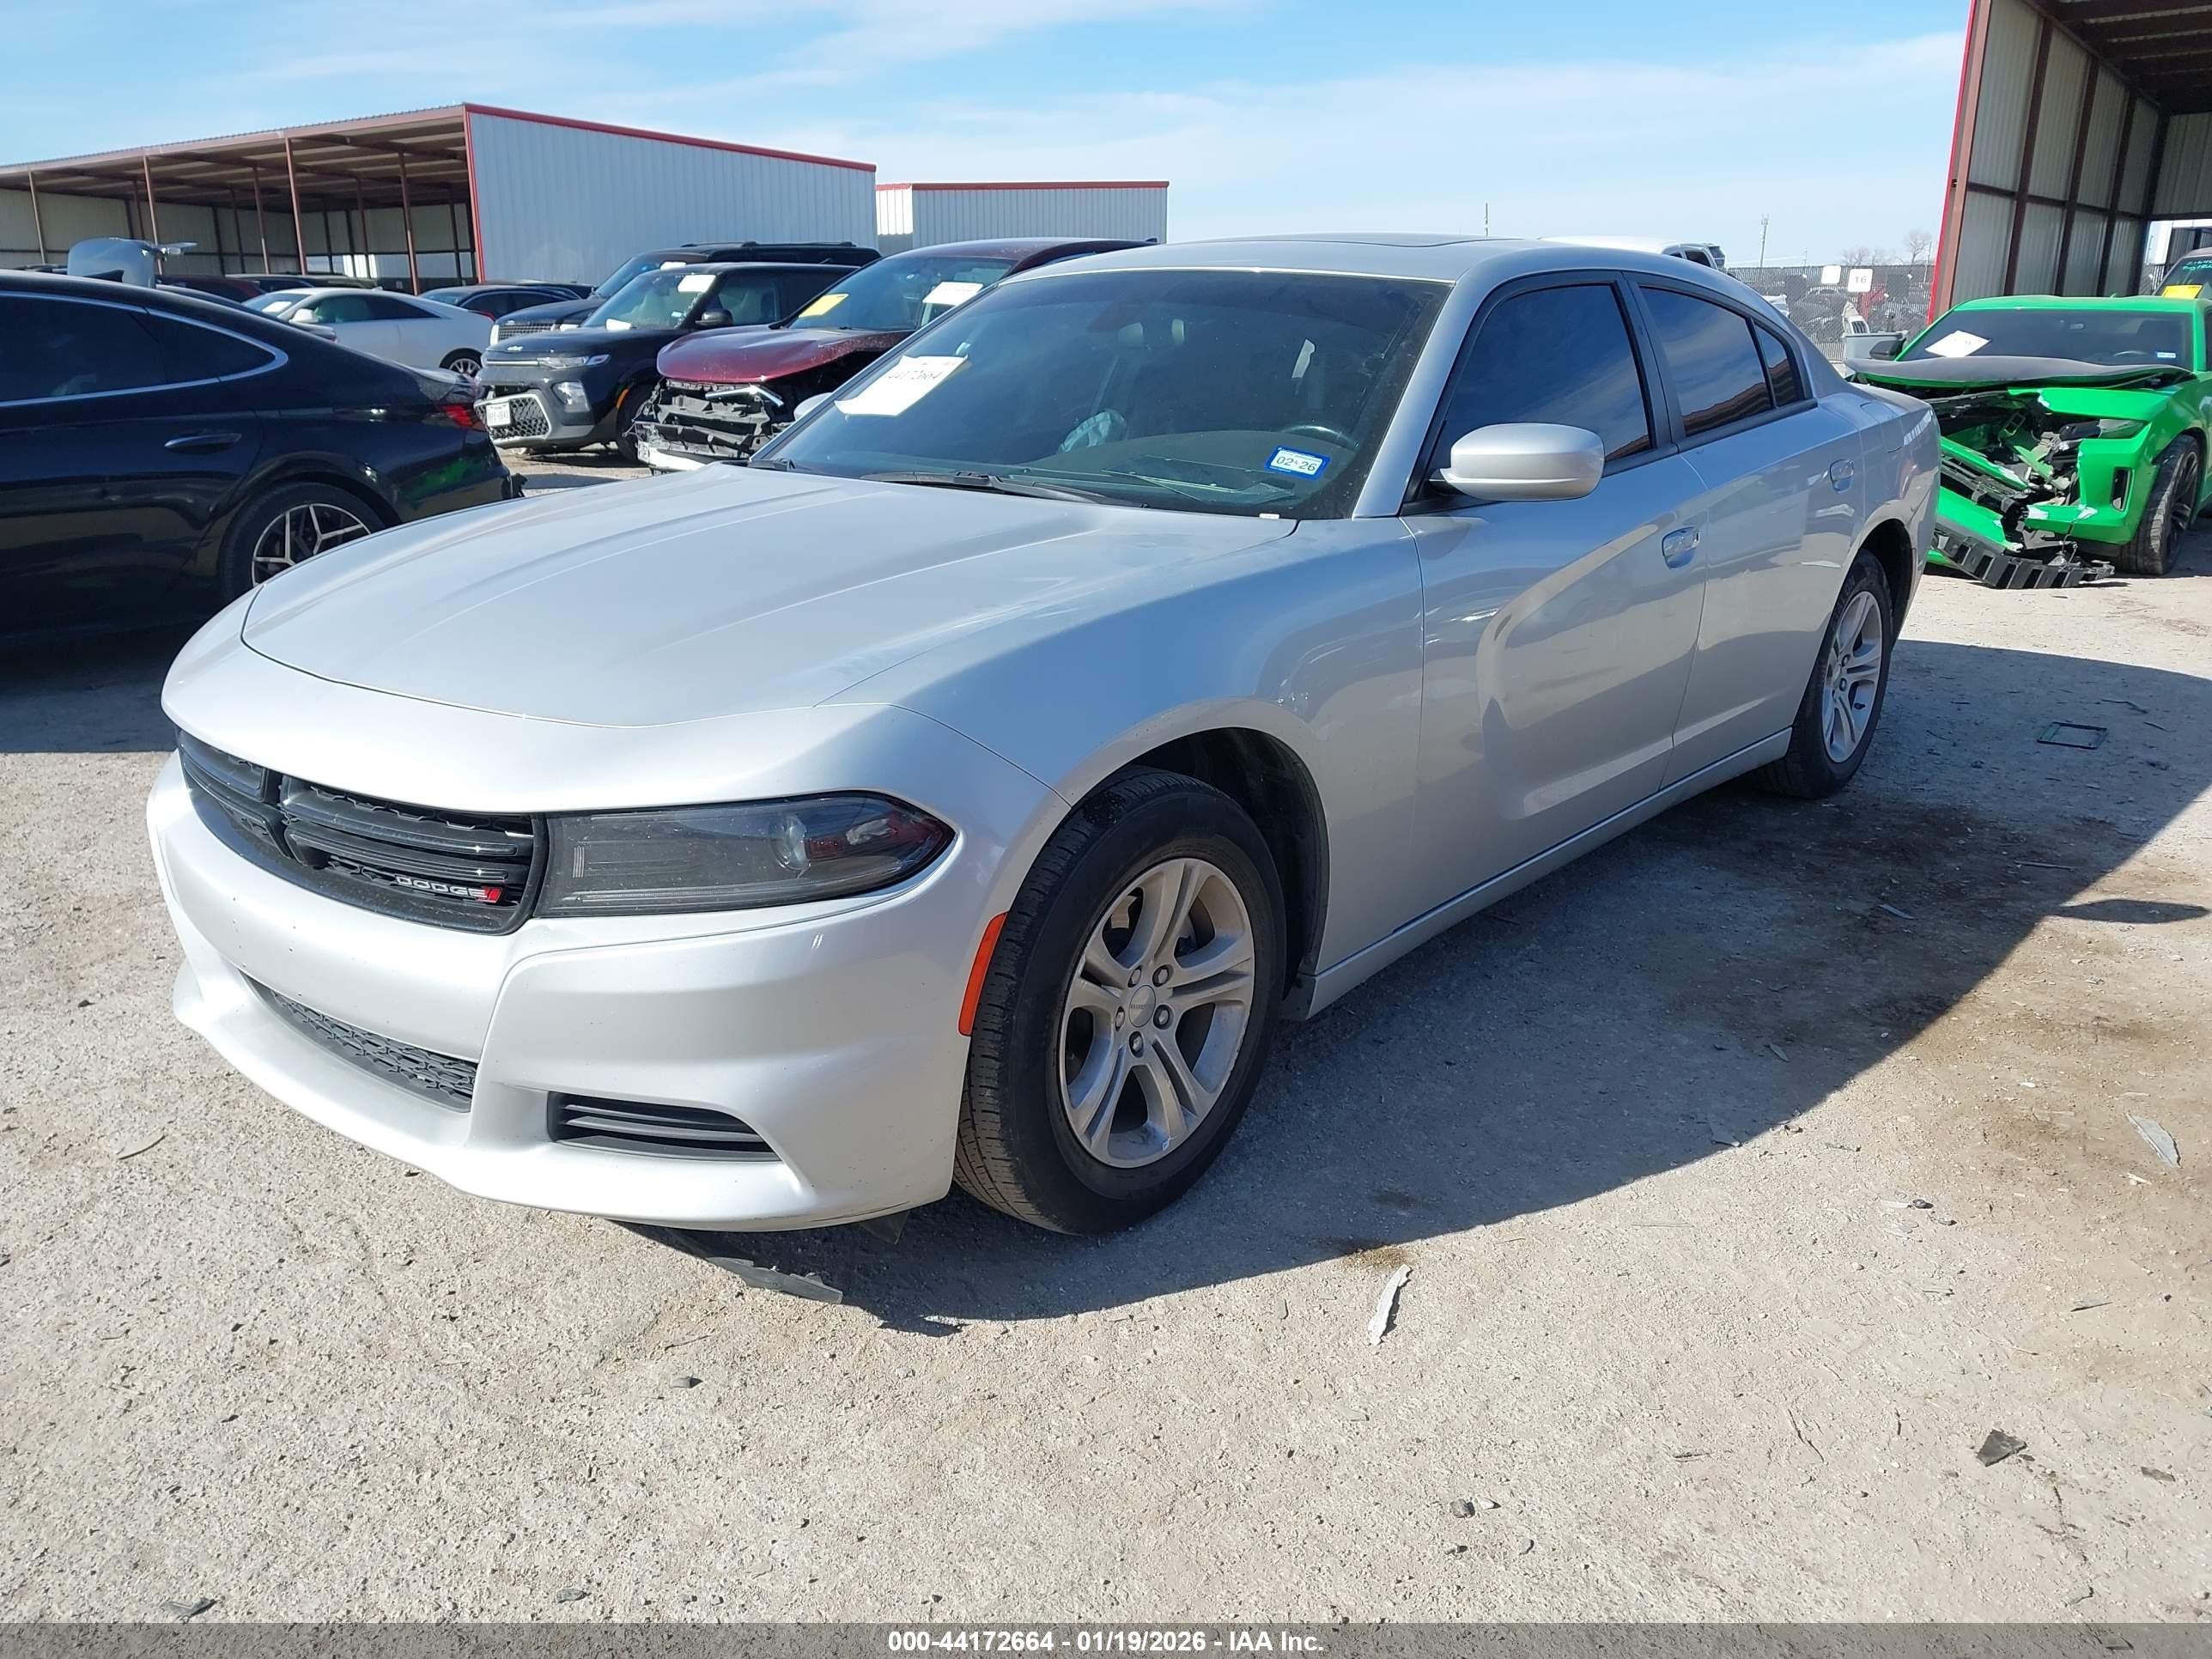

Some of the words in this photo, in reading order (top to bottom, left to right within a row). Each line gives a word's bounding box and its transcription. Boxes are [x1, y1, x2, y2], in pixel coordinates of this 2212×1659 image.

[1276, 456, 1293, 466] 02
[1298, 460, 1317, 471] 26
[396, 876, 488, 899] DODGE
